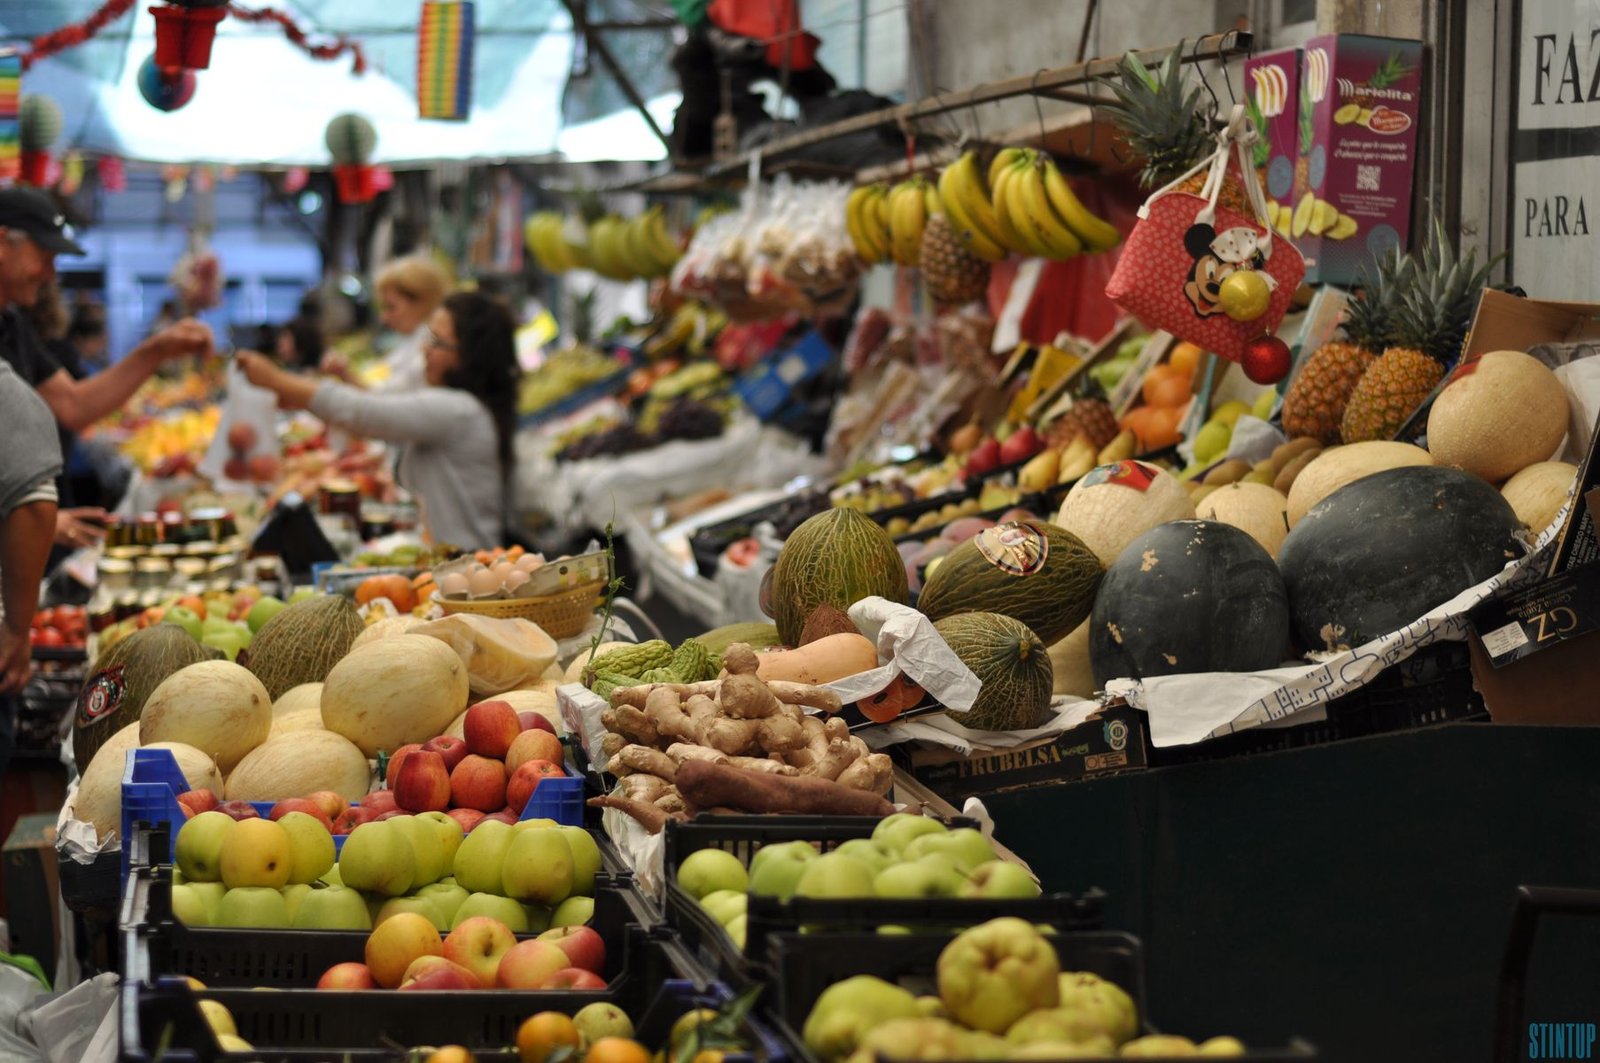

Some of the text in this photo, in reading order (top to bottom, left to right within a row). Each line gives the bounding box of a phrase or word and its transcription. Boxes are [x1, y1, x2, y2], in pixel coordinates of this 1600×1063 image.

[1524, 195, 1589, 238] PARA
[1527, 606, 1578, 642] GZ
[959, 744, 1062, 779] FRUBELSA
